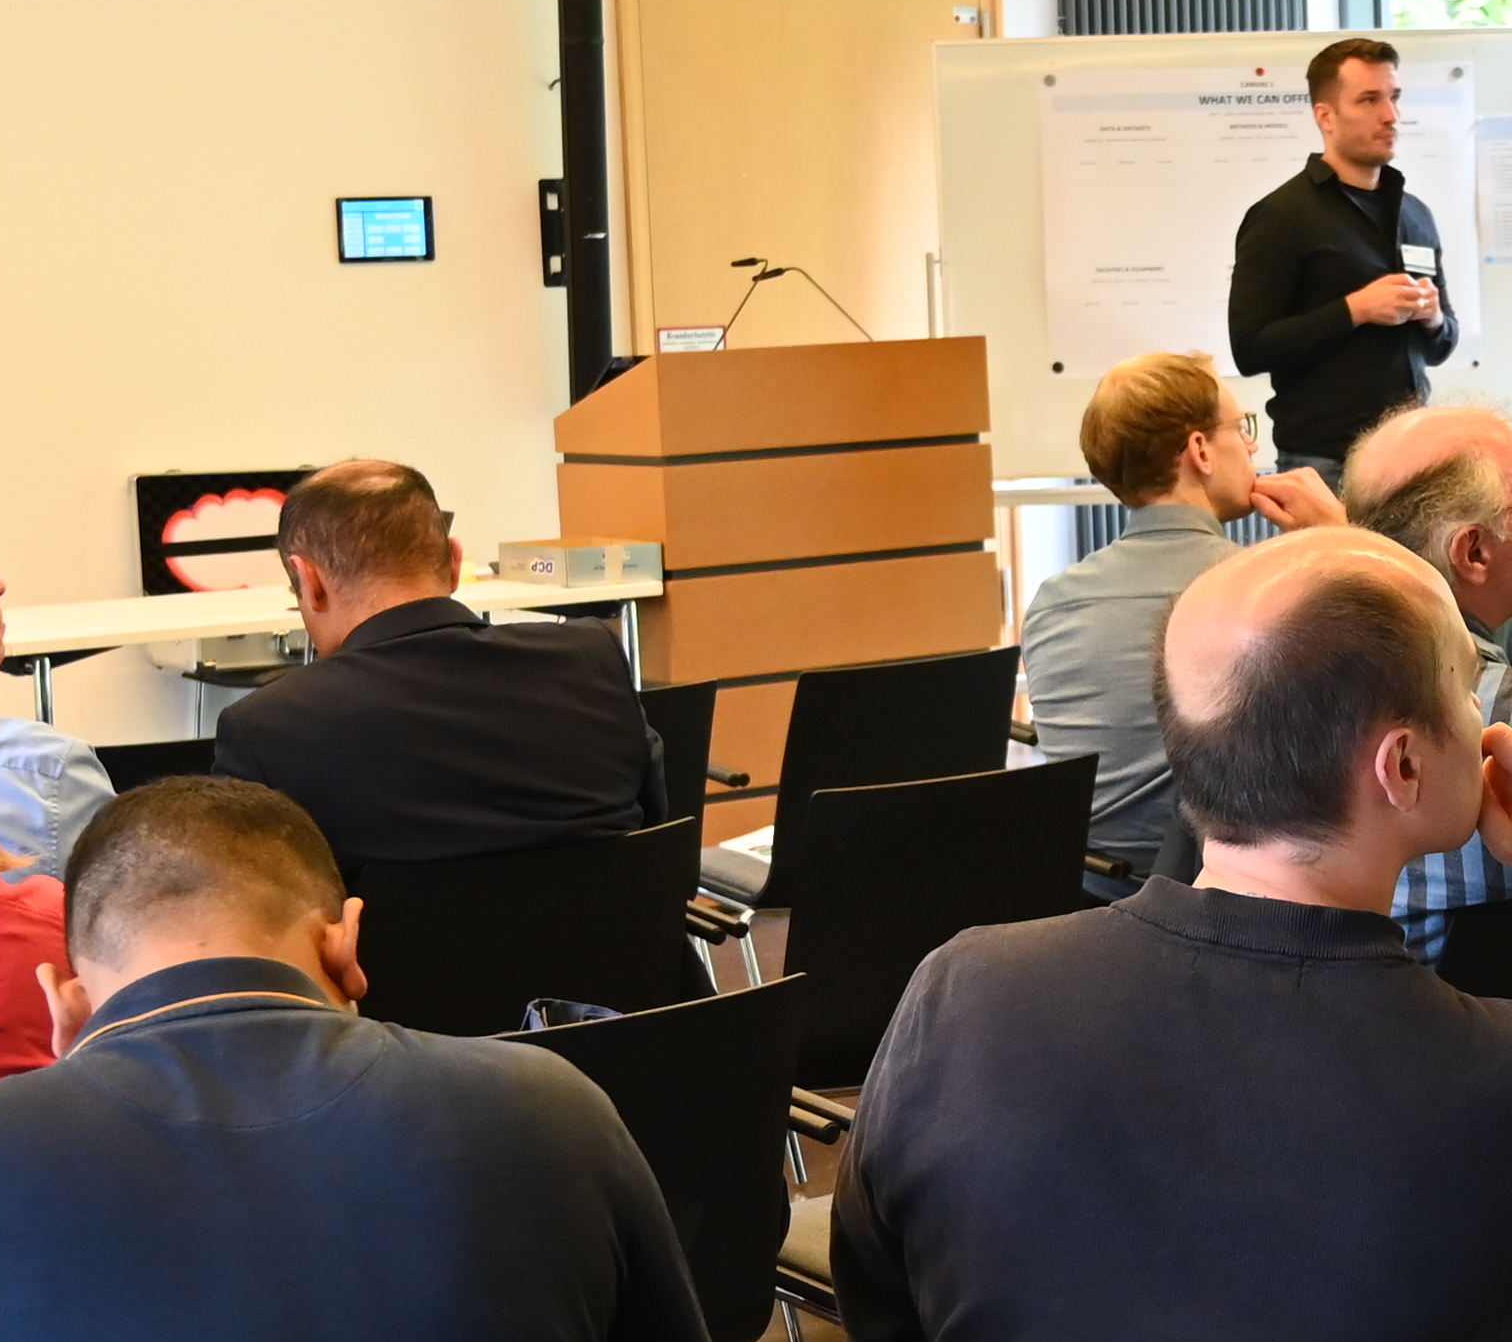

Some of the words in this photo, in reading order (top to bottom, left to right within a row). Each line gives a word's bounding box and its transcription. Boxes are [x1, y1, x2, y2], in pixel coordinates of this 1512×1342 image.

[1199, 95, 1232, 106] WHAT
[1236, 95, 1253, 105] WE
[1257, 94, 1280, 105] CAN
[1283, 93, 1310, 104] OFFE
[531, 560, 553, 573] DCP
